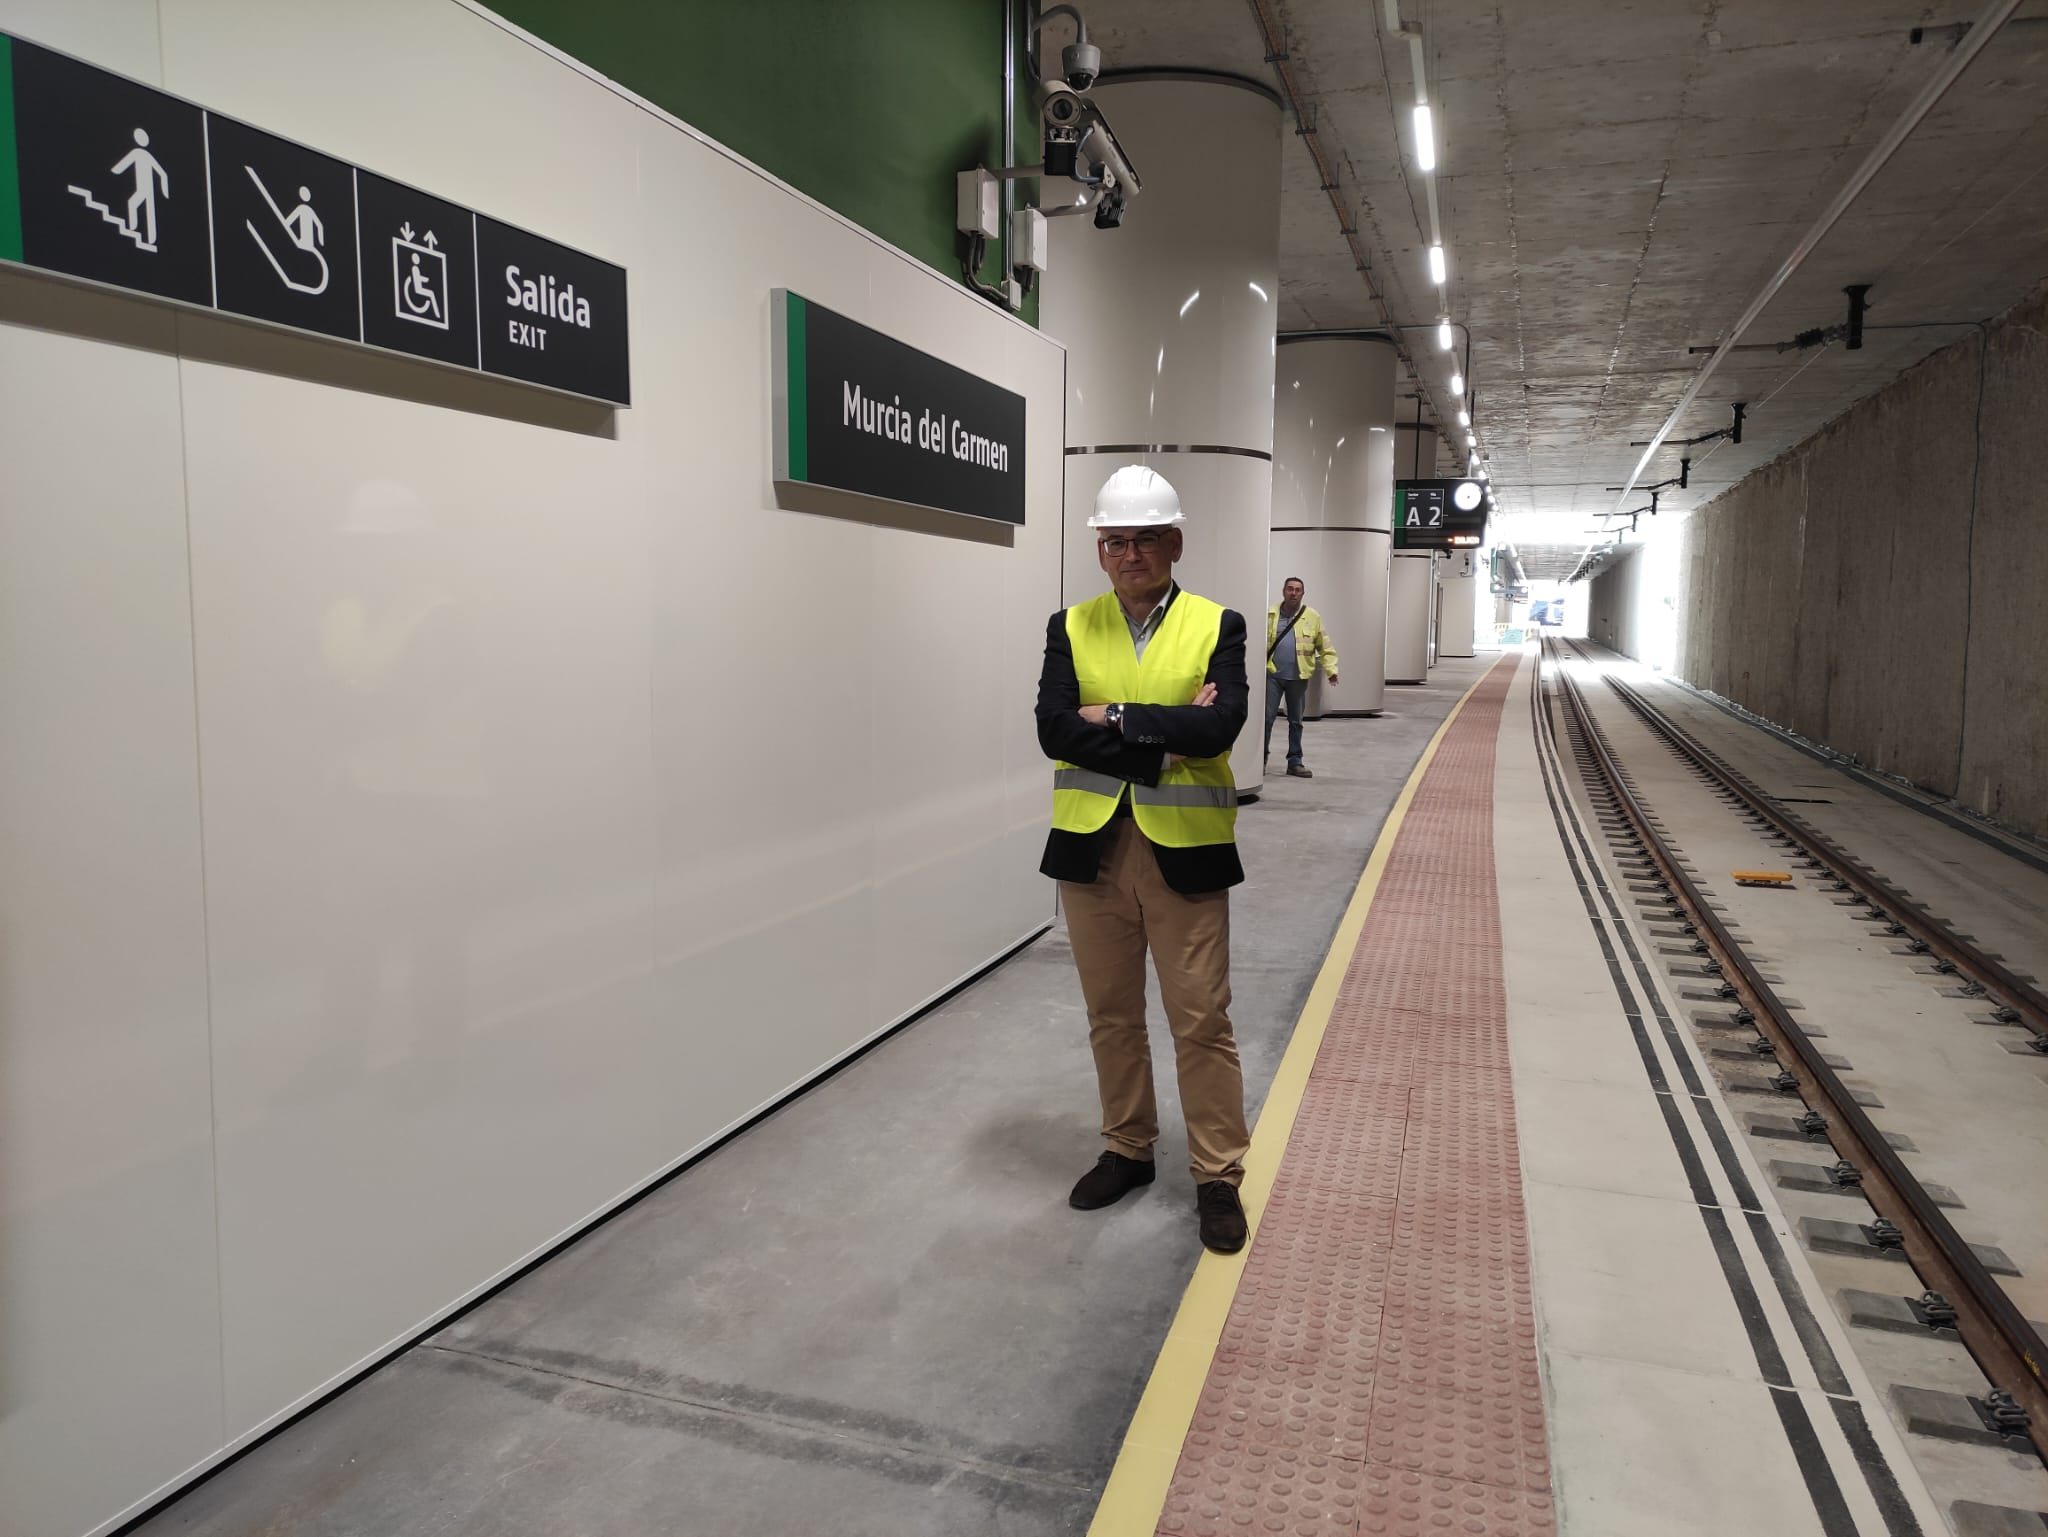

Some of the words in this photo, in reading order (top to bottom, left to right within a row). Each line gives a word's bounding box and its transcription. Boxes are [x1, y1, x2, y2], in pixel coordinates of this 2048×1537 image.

[505, 264, 591, 329] Salida
[509, 320, 547, 351] EXIT
[843, 380, 912, 445] Murcia
[918, 408, 946, 455] del
[951, 419, 1008, 473] Carmen
[1406, 506, 1421, 526] A
[1428, 506, 1441, 526] 2
